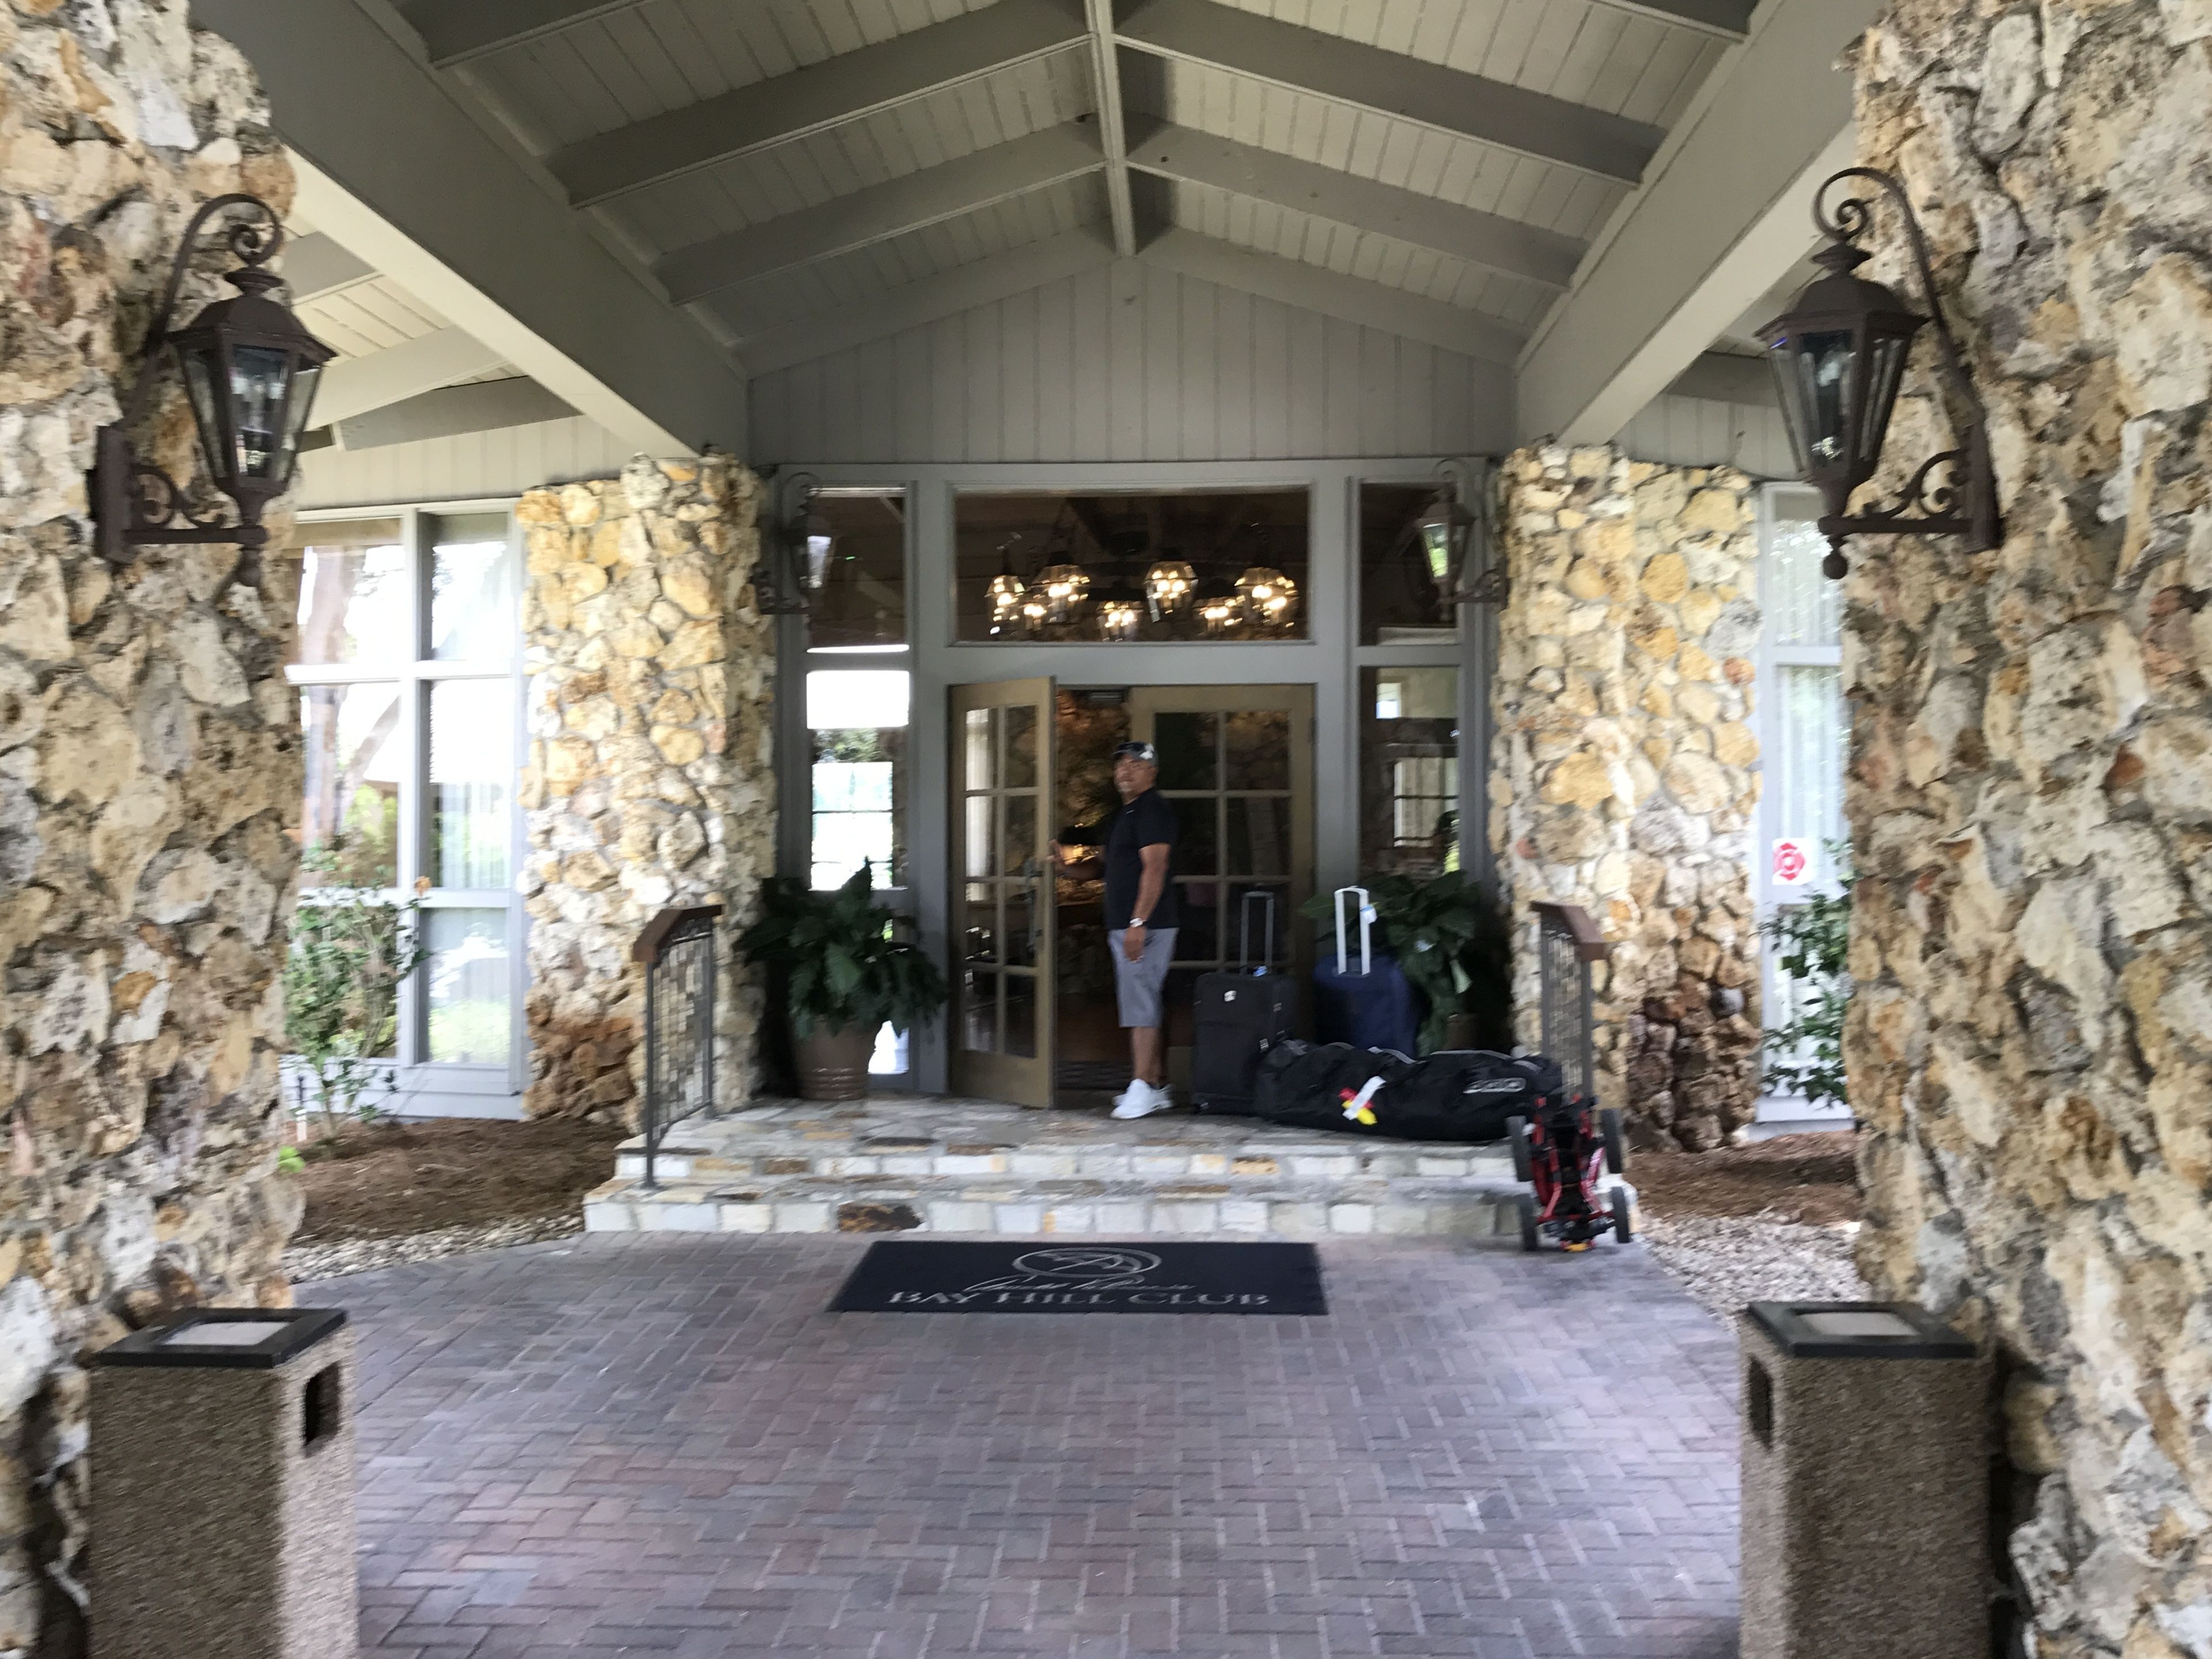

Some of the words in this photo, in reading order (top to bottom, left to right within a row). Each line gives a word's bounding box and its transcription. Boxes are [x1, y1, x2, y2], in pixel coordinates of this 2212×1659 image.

[885, 1290, 981, 1304] BAY
[993, 1291, 1117, 1305] HILL
[1127, 1293, 1270, 1305] CLUB
